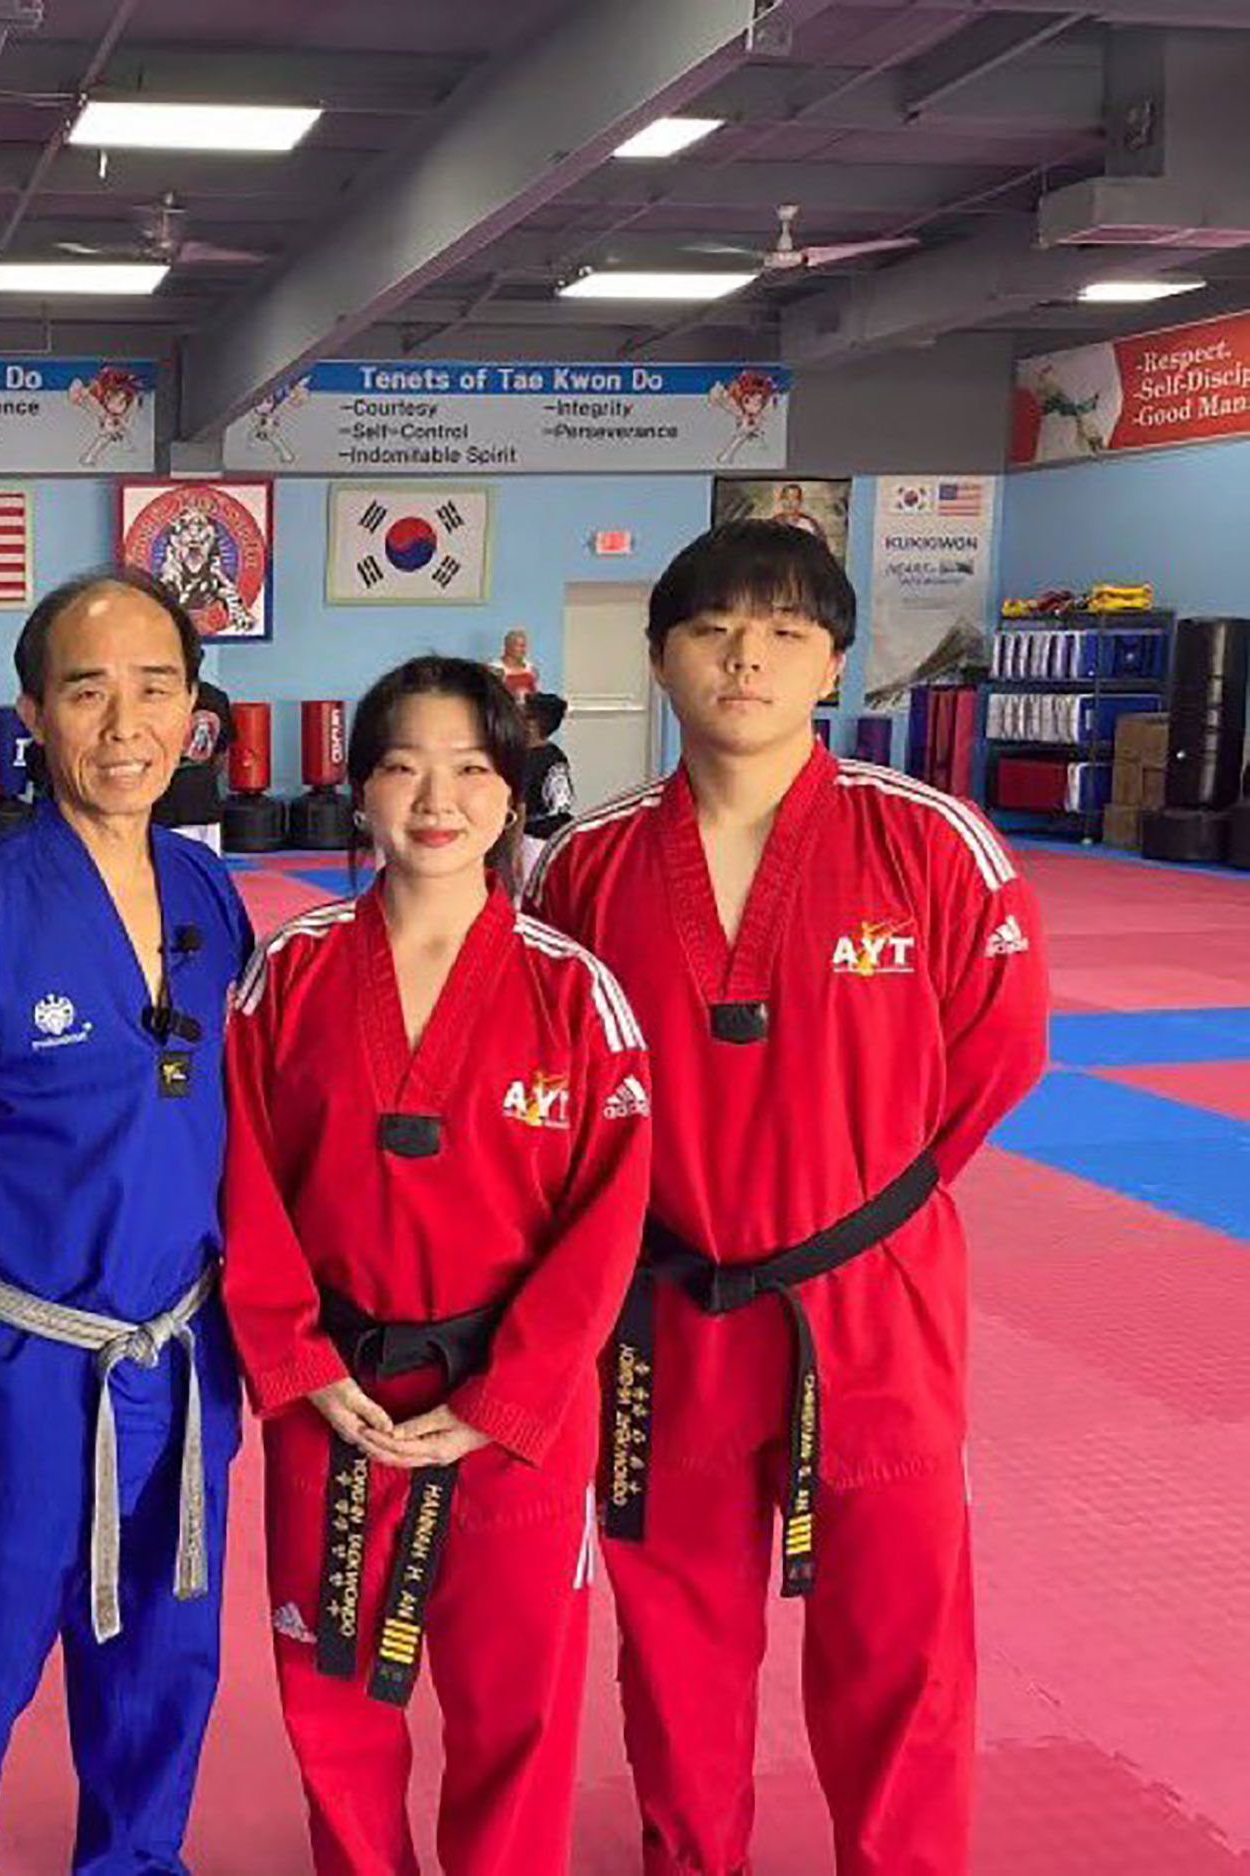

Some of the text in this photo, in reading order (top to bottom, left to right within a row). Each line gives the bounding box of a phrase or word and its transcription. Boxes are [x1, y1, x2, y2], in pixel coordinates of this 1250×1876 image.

[6, 365, 42, 389] Do
[360, 366, 663, 391] Tenets of Tae Kwon Do
[1197, 393, 1250, 418] Man
[466, 446, 517, 464] Spirit
[833, 936, 914, 965] AYT
[411, 1483, 444, 1561] HANNAH
